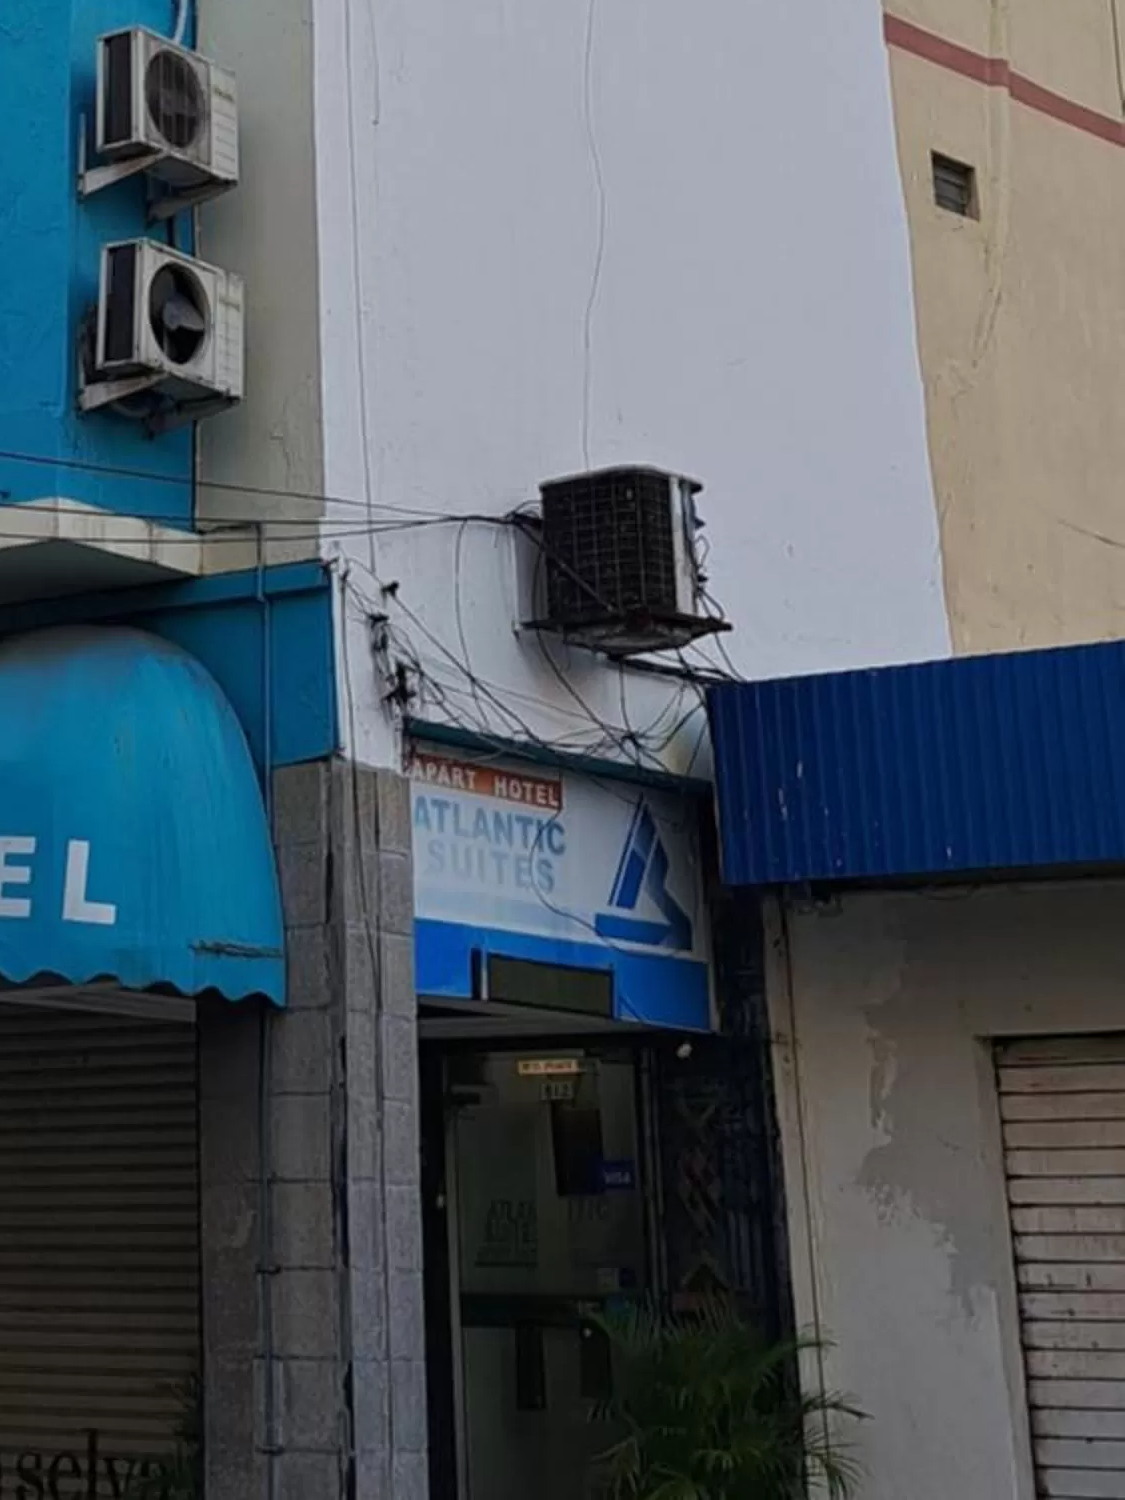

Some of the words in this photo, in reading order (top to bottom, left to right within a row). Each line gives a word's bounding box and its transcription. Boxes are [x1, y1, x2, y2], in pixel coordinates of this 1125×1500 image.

[410, 758, 477, 790] APART
[494, 774, 560, 807] HOTEL
[414, 794, 567, 855] ATLANTIC
[427, 838, 556, 894] SUITES
